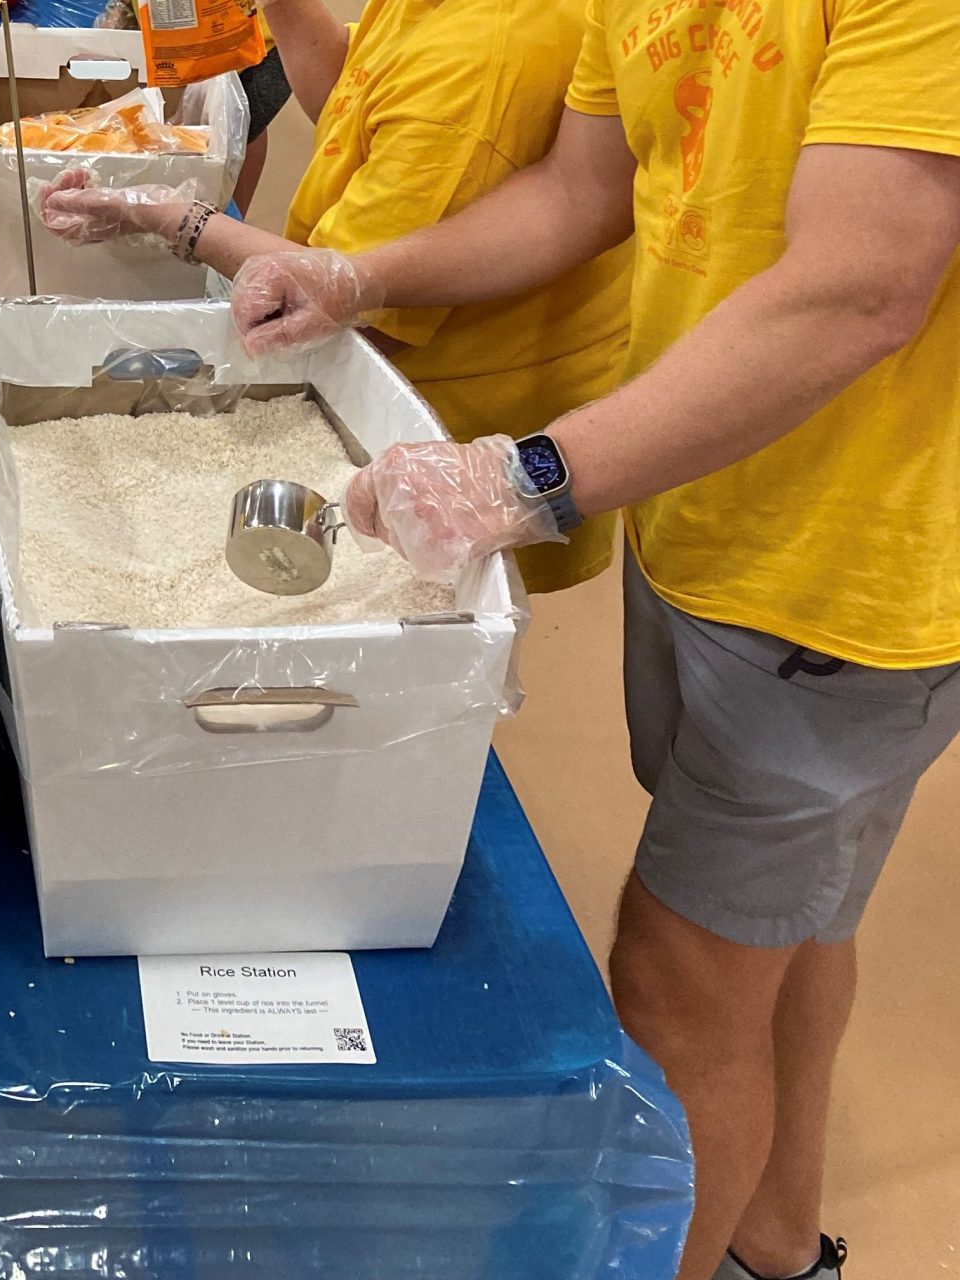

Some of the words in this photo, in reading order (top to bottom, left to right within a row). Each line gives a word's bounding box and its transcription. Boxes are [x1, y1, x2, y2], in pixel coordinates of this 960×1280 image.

[622, 26, 639, 57] IT
[753, 41, 784, 72] U
[646, 30, 681, 72] BIG
[200, 965, 236, 977] Rice
[241, 966, 297, 978] Station
